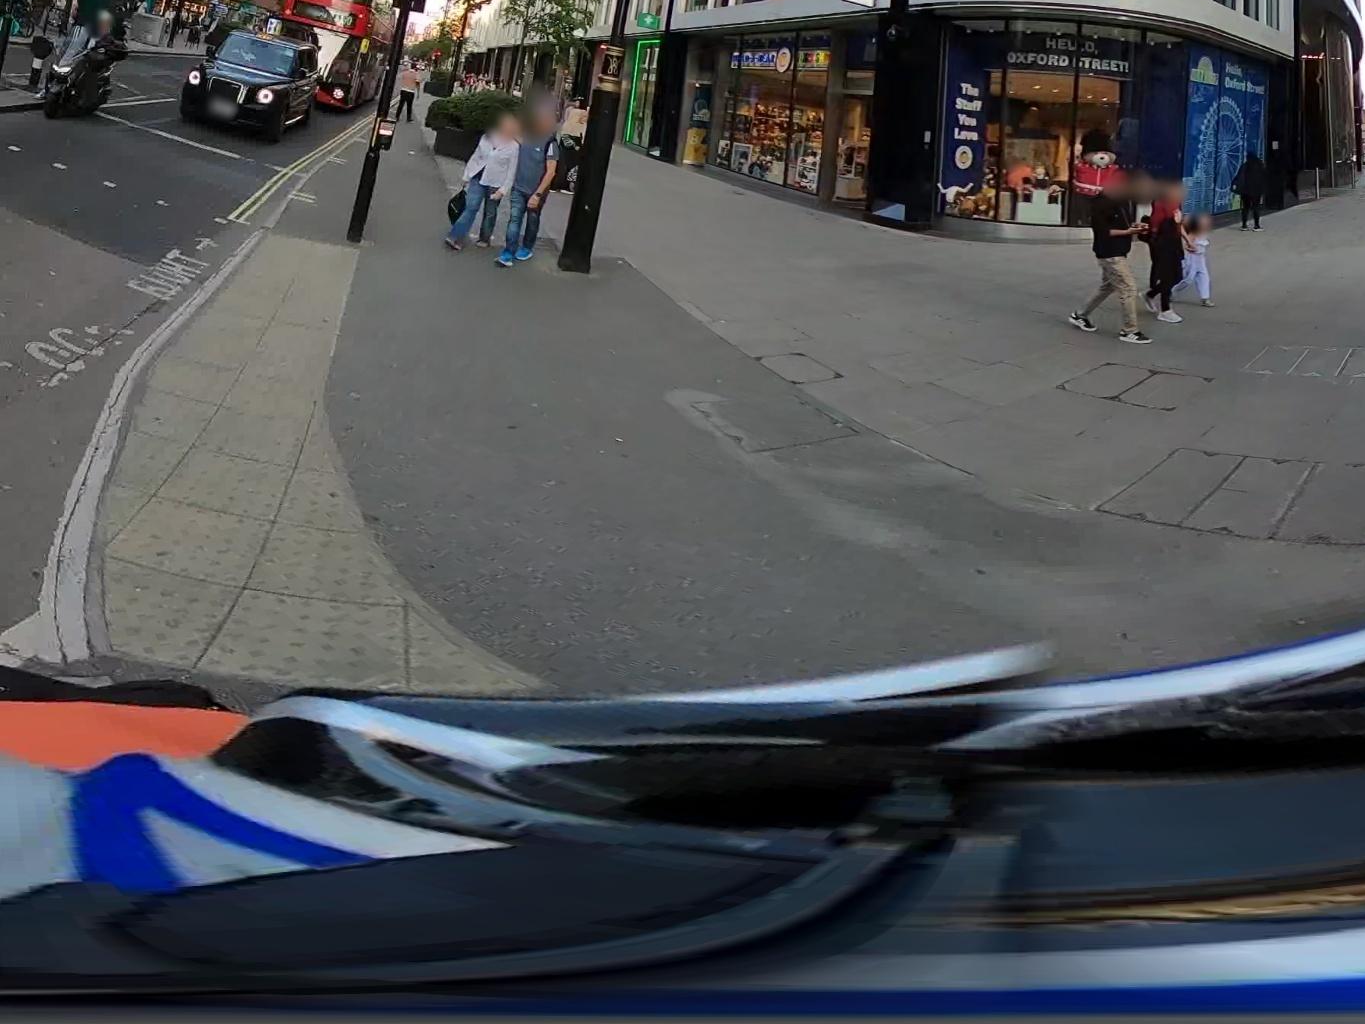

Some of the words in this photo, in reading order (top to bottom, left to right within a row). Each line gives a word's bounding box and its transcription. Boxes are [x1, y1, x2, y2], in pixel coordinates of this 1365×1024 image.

[1007, 51, 1070, 68] OXFORD
[960, 82, 980, 97] The
[957, 113, 978, 127] You
